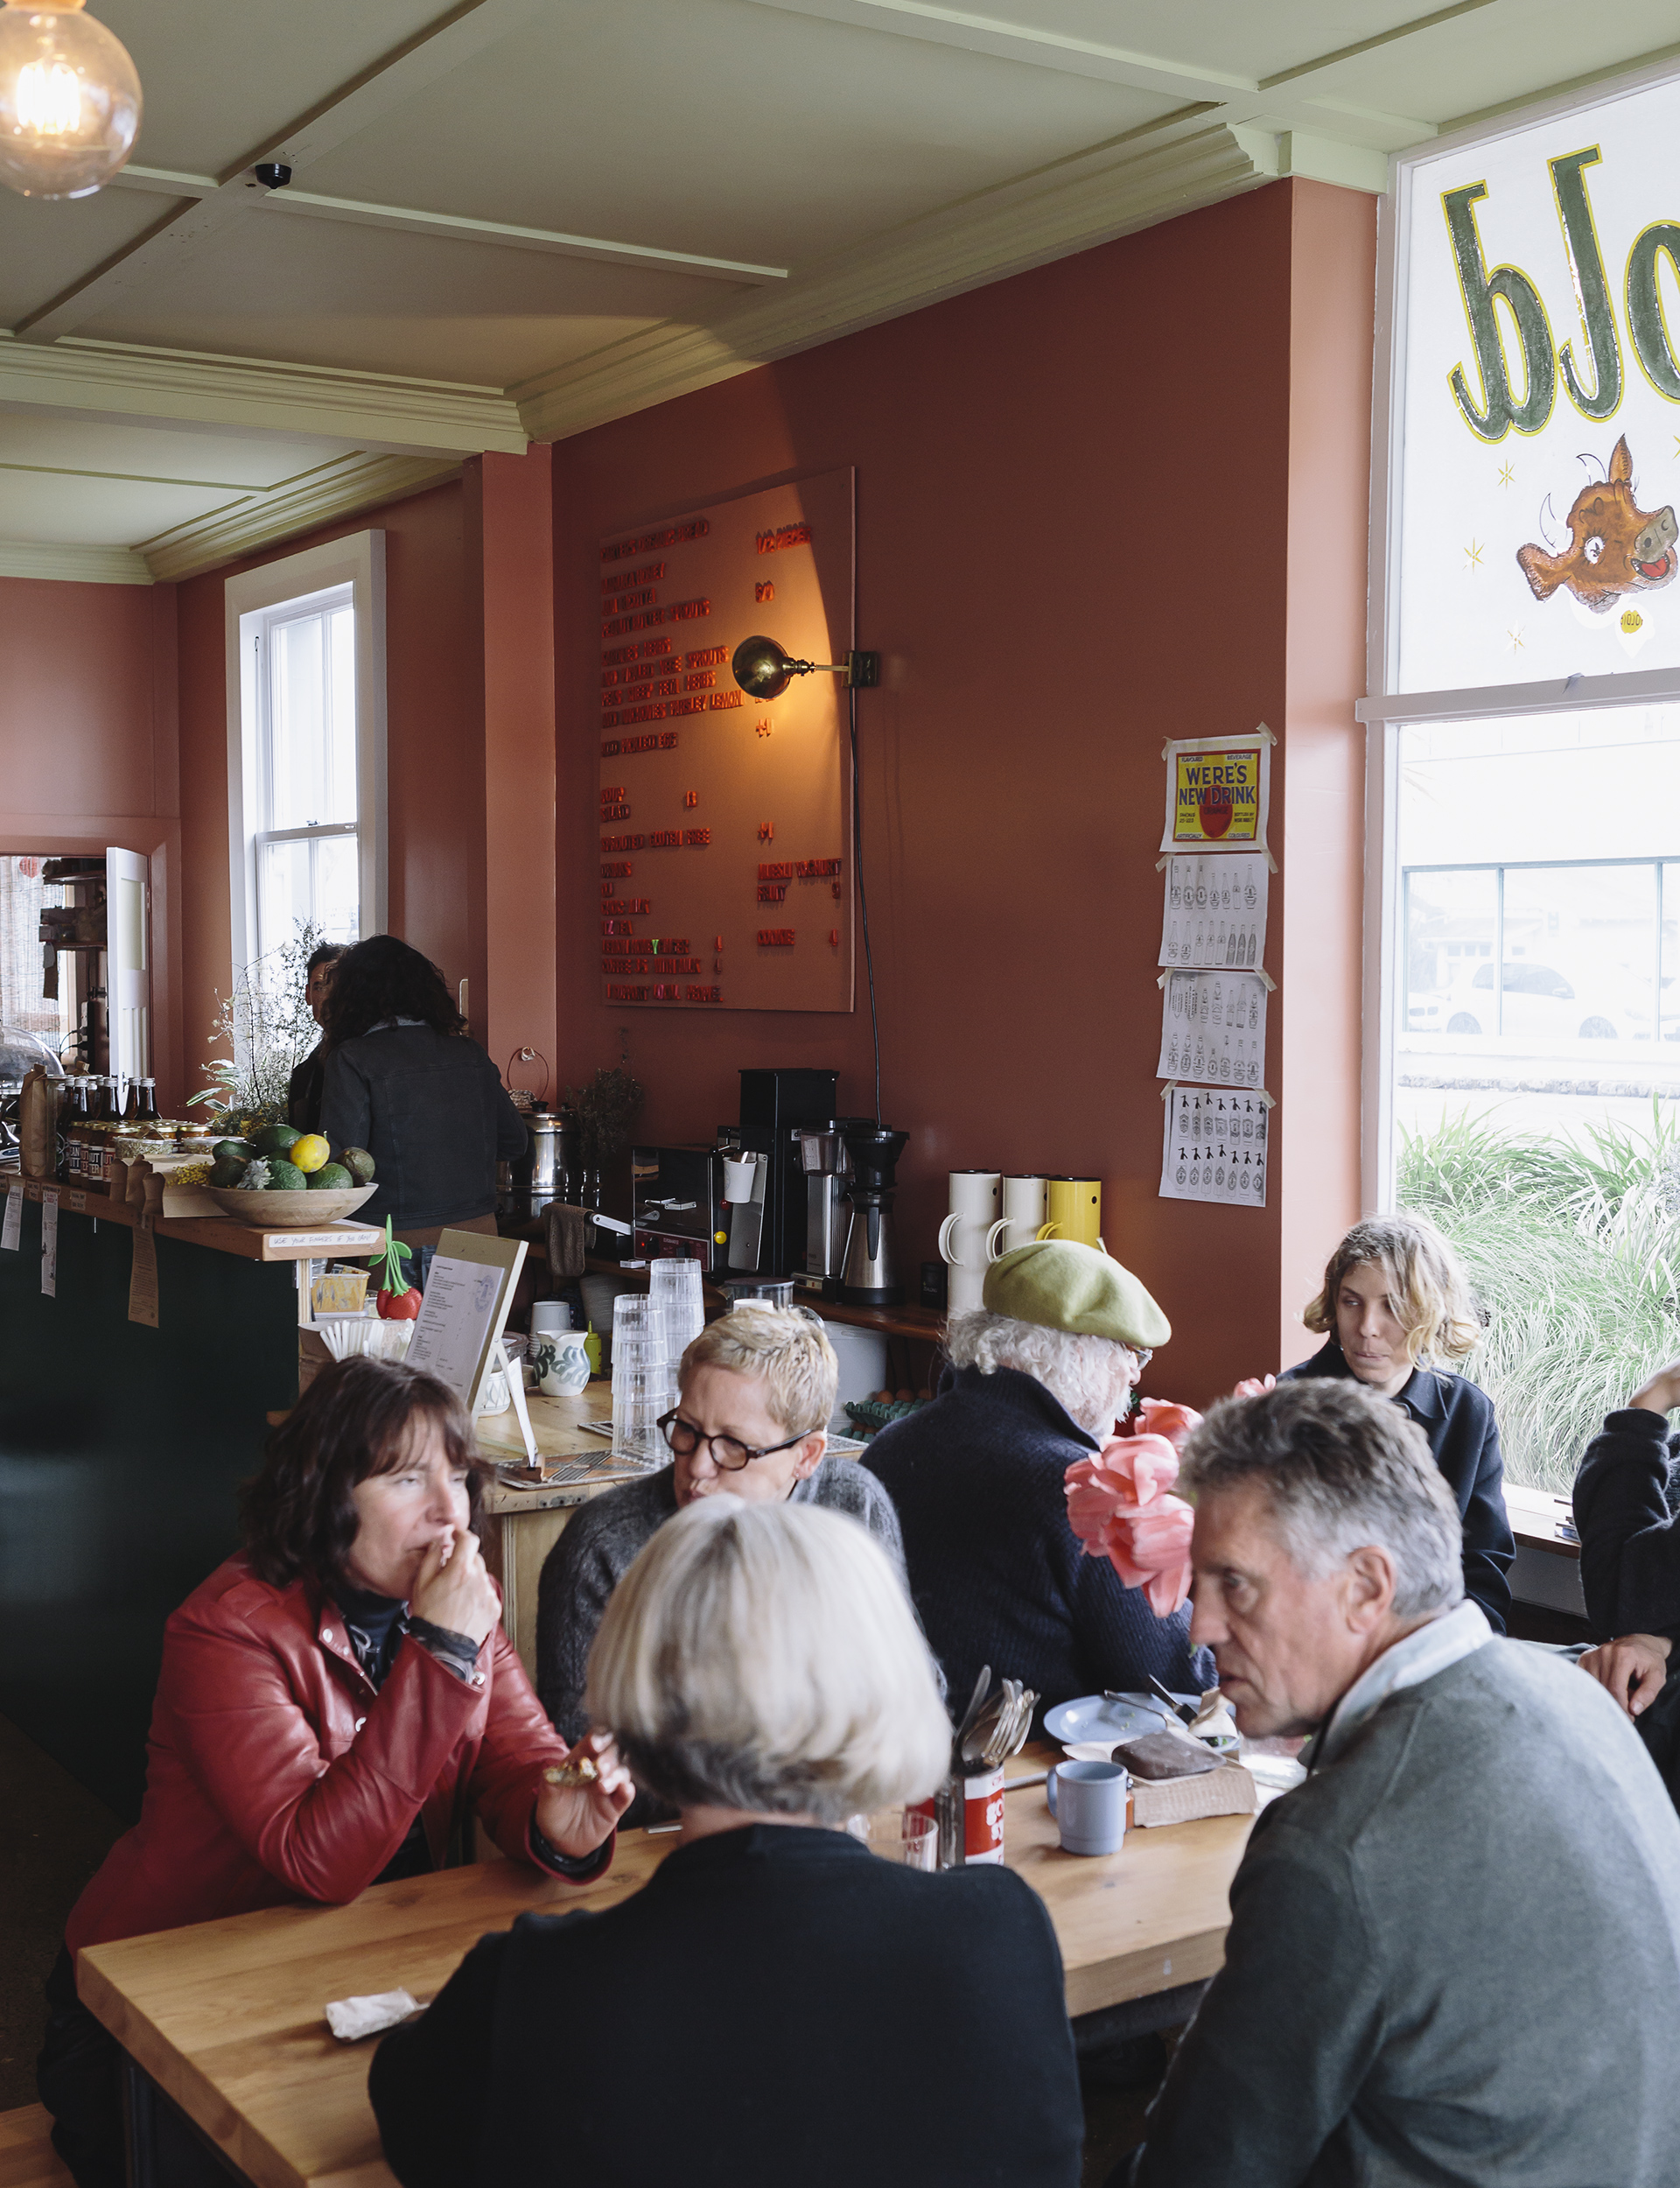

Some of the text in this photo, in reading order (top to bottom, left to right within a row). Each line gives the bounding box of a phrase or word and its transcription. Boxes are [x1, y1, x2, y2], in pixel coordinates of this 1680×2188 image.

[636, 562, 666, 585] HONEY
[686, 646, 730, 669] SPROUTS
[669, 694, 708, 716] PARSLEY
[710, 689, 744, 711] LEMON
[1186, 761, 1248, 785] WERE'S
[601, 787, 625, 804] SOUP
[1179, 786, 1256, 805] NEW DRINK
[649, 830, 683, 847] GLUTEN
[686, 828, 710, 845] FREE
[758, 858, 842, 880] MUESLI YOGHURT
[757, 884, 787, 901] FRUIT
[291, 1237, 305, 1246] YOUR
